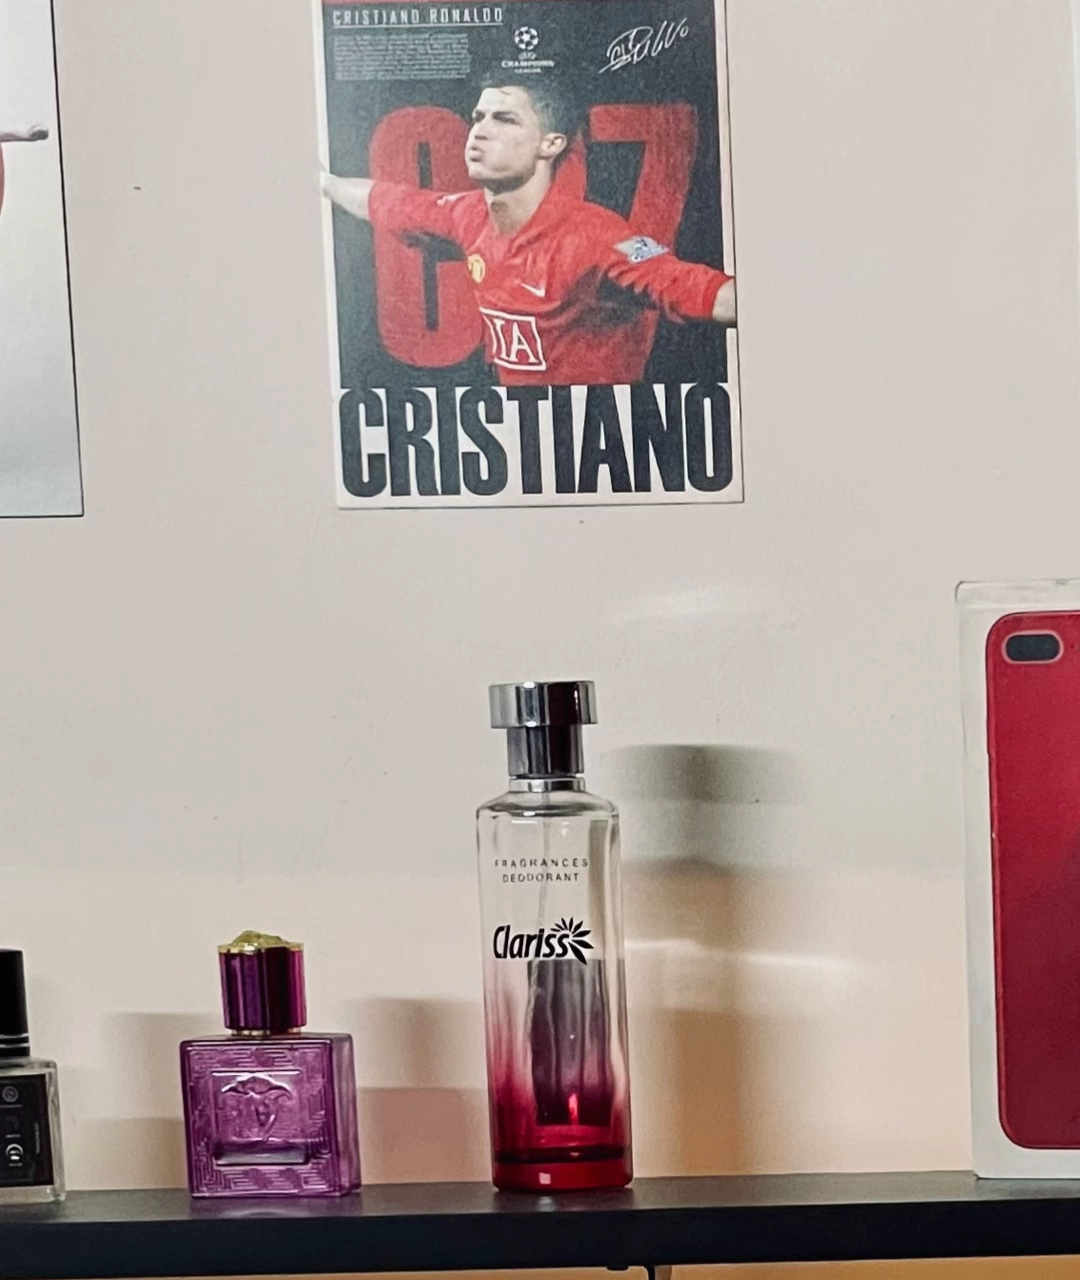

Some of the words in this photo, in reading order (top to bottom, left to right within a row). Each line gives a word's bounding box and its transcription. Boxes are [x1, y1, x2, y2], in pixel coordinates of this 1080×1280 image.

[332, 9, 420, 25] CRISTIANO
[429, 7, 503, 24] RONALDO
[339, 382, 733, 498] CRISTIANO
[495, 858, 589, 868] FRAGRANCES
[502, 872, 580, 883] DEODORANT
